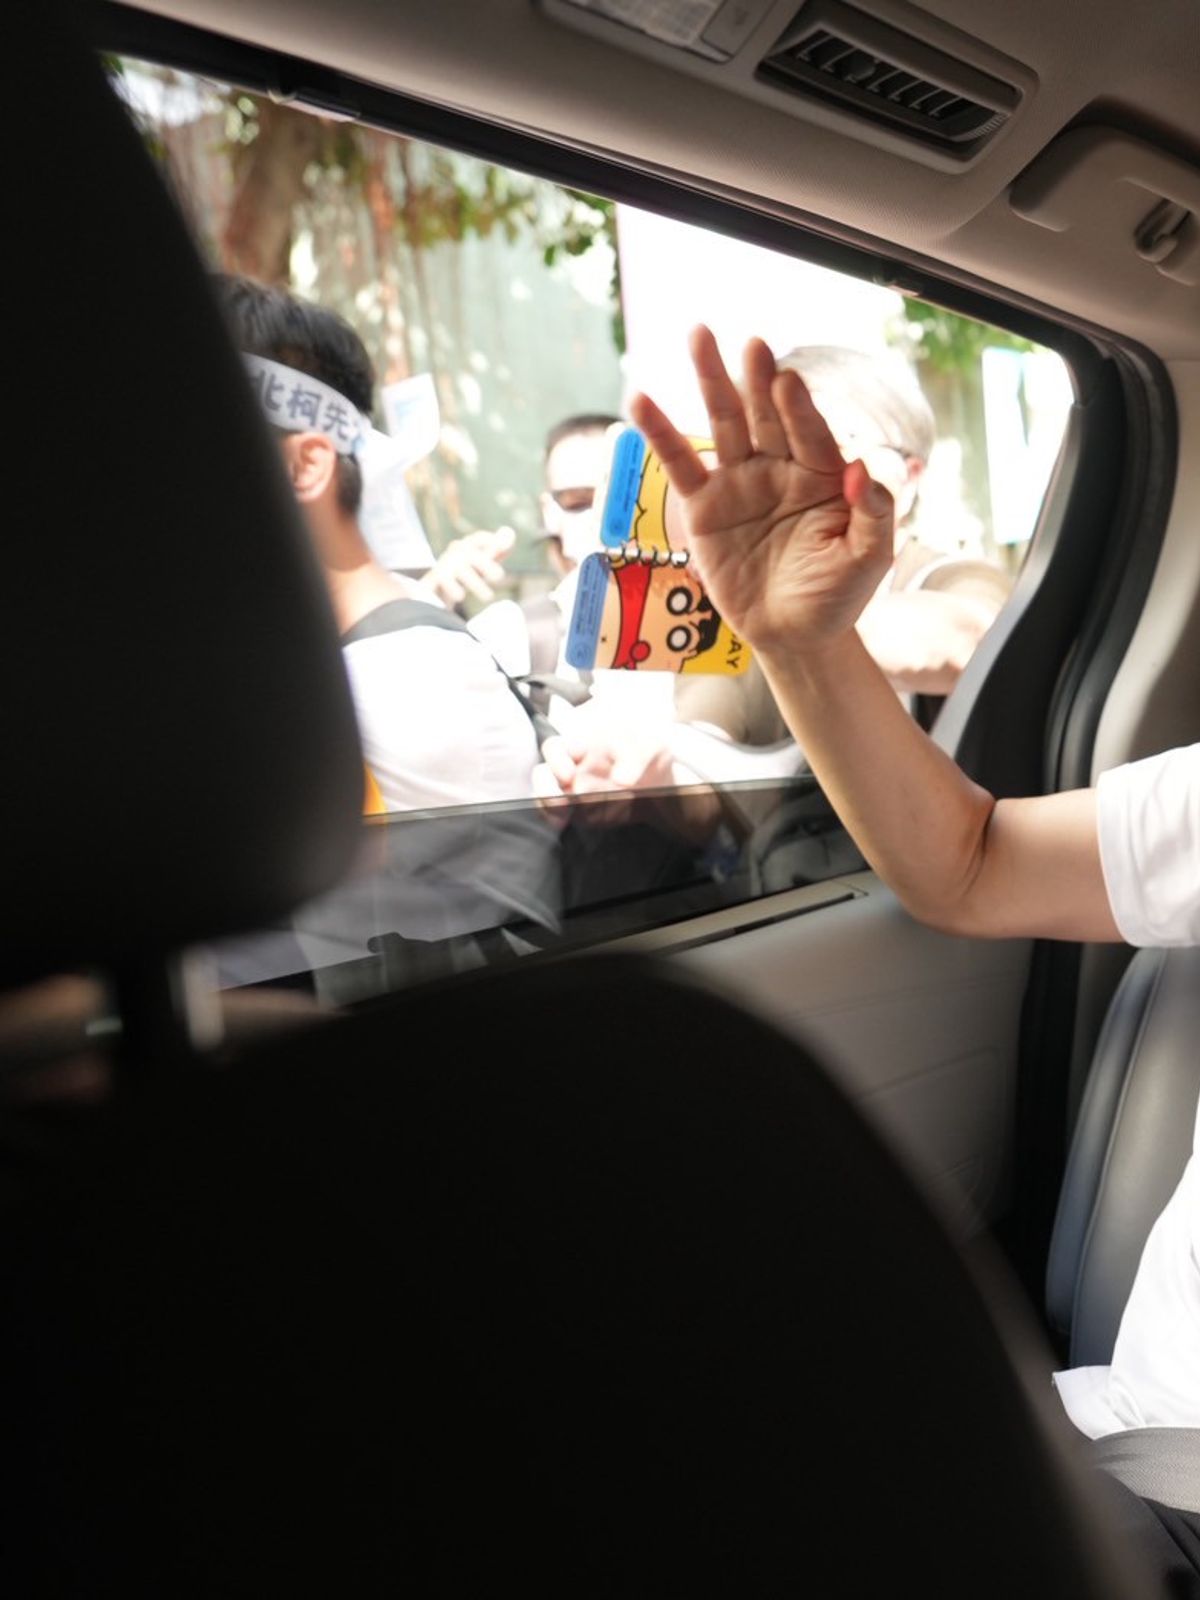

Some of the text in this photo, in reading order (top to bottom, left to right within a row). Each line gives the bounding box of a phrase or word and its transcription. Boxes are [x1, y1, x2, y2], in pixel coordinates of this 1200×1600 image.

[251, 370, 360, 440] 北柯先
[726, 634, 743, 669] AY
